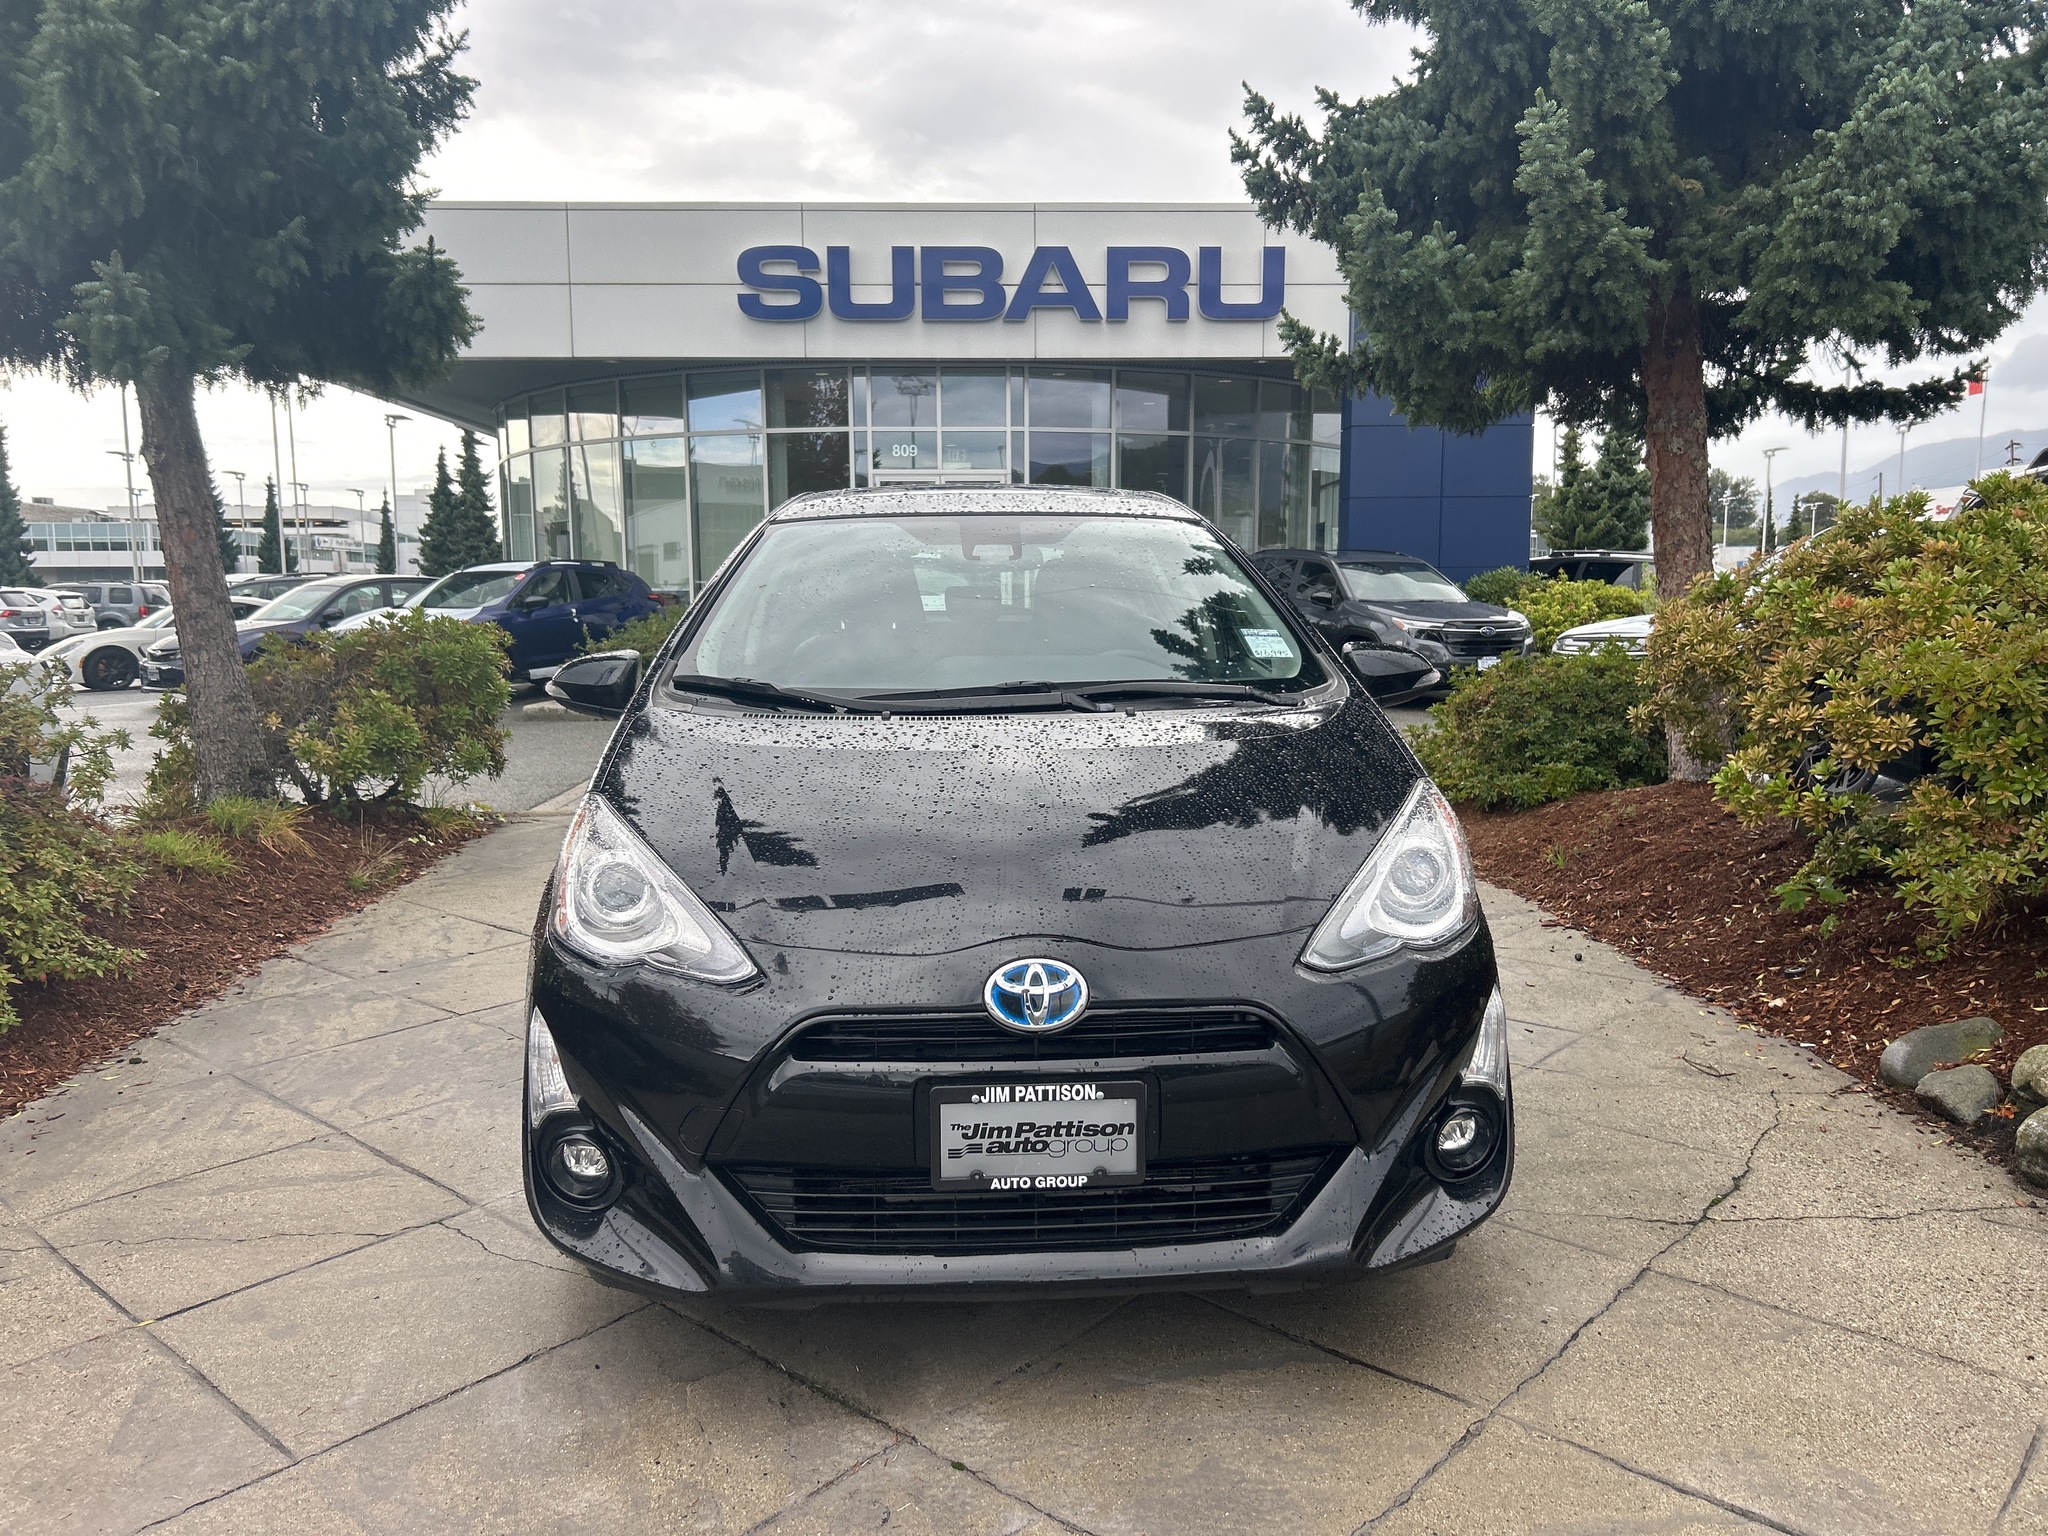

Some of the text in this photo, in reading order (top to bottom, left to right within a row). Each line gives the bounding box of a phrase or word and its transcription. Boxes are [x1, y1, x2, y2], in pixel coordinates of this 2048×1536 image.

[737, 245, 1286, 323] SUBARU
[892, 444, 918, 457] 809
[981, 1084, 1096, 1103] JIM PATTISON
[950, 1120, 1135, 1140] The Jim Pattison
[990, 1175, 1088, 1190] AUTO GROUP
